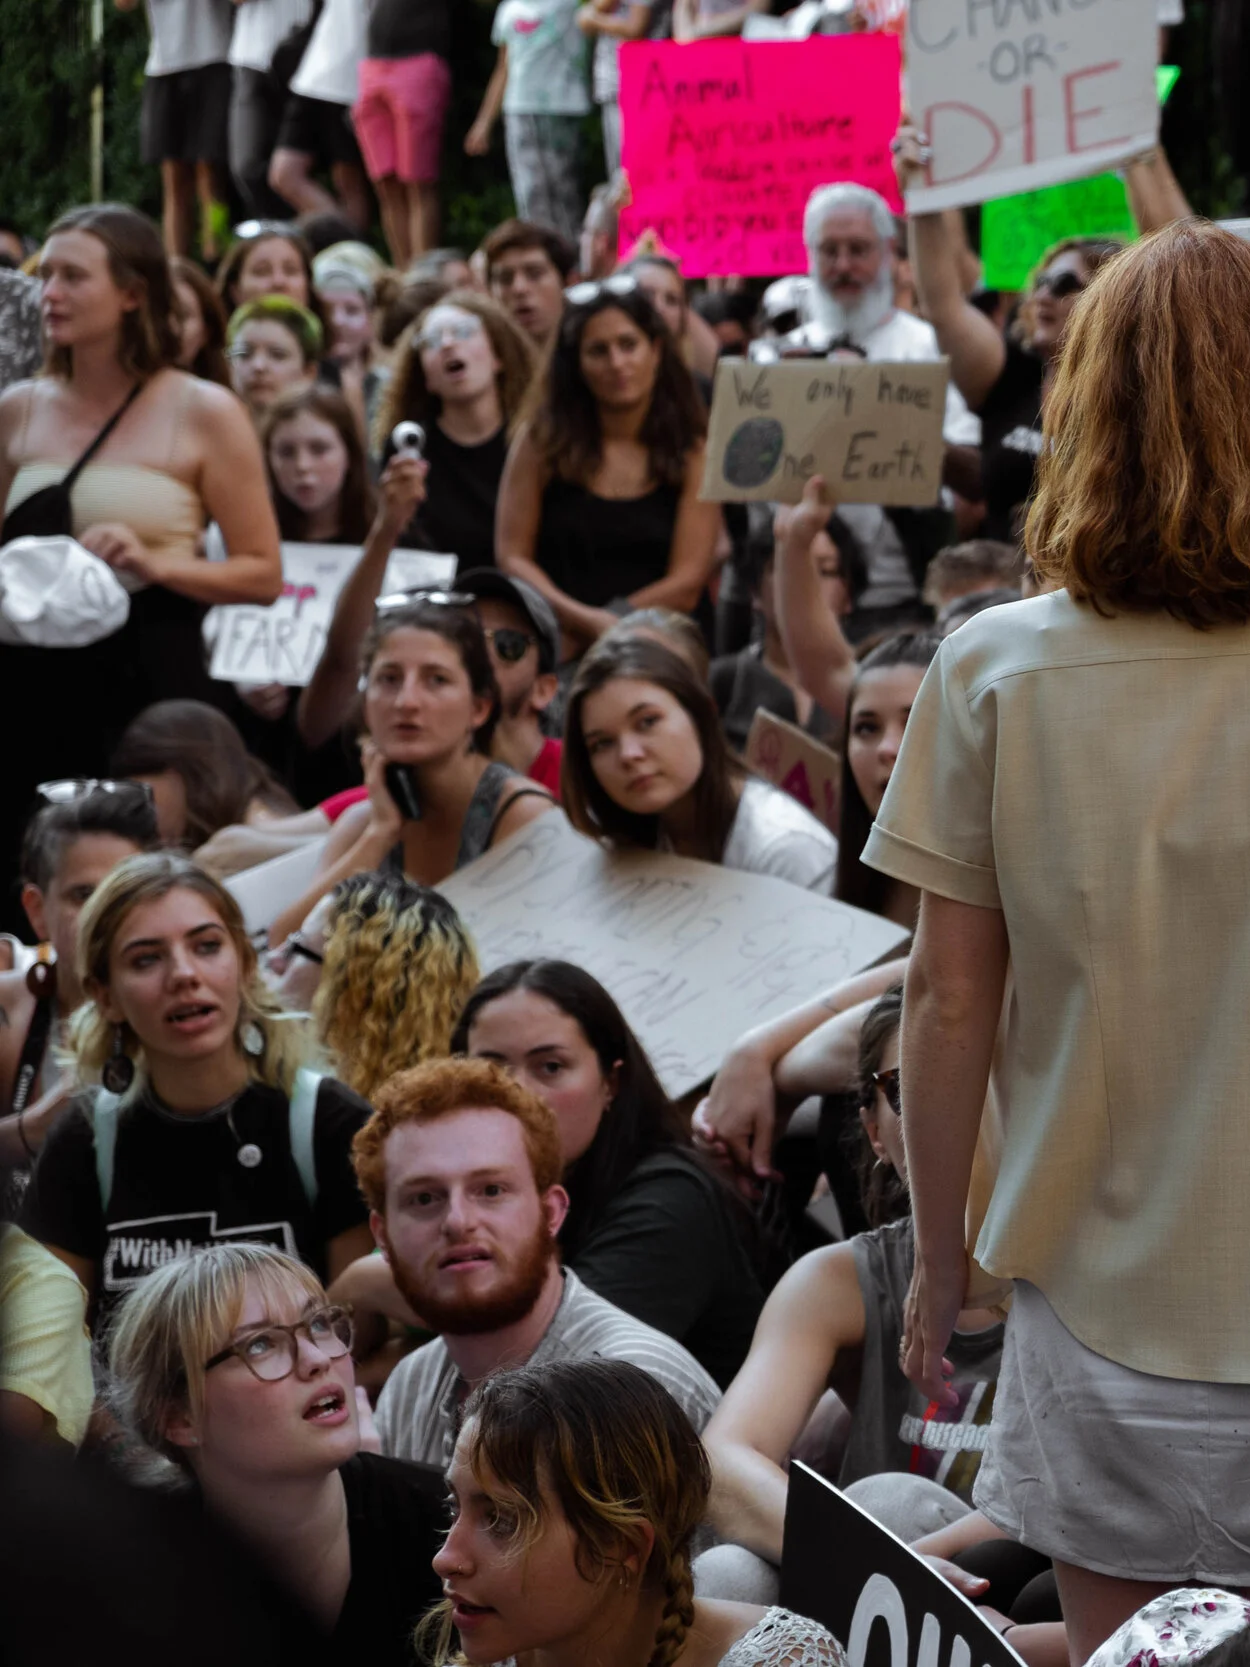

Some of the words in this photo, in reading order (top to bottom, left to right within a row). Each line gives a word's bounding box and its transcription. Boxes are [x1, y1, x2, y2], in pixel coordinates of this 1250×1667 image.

[923, 60, 1132, 188] DIE
[733, 367, 773, 409] We
[806, 365, 854, 417] only
[877, 371, 932, 409] have
[842, 430, 925, 482] Earth
